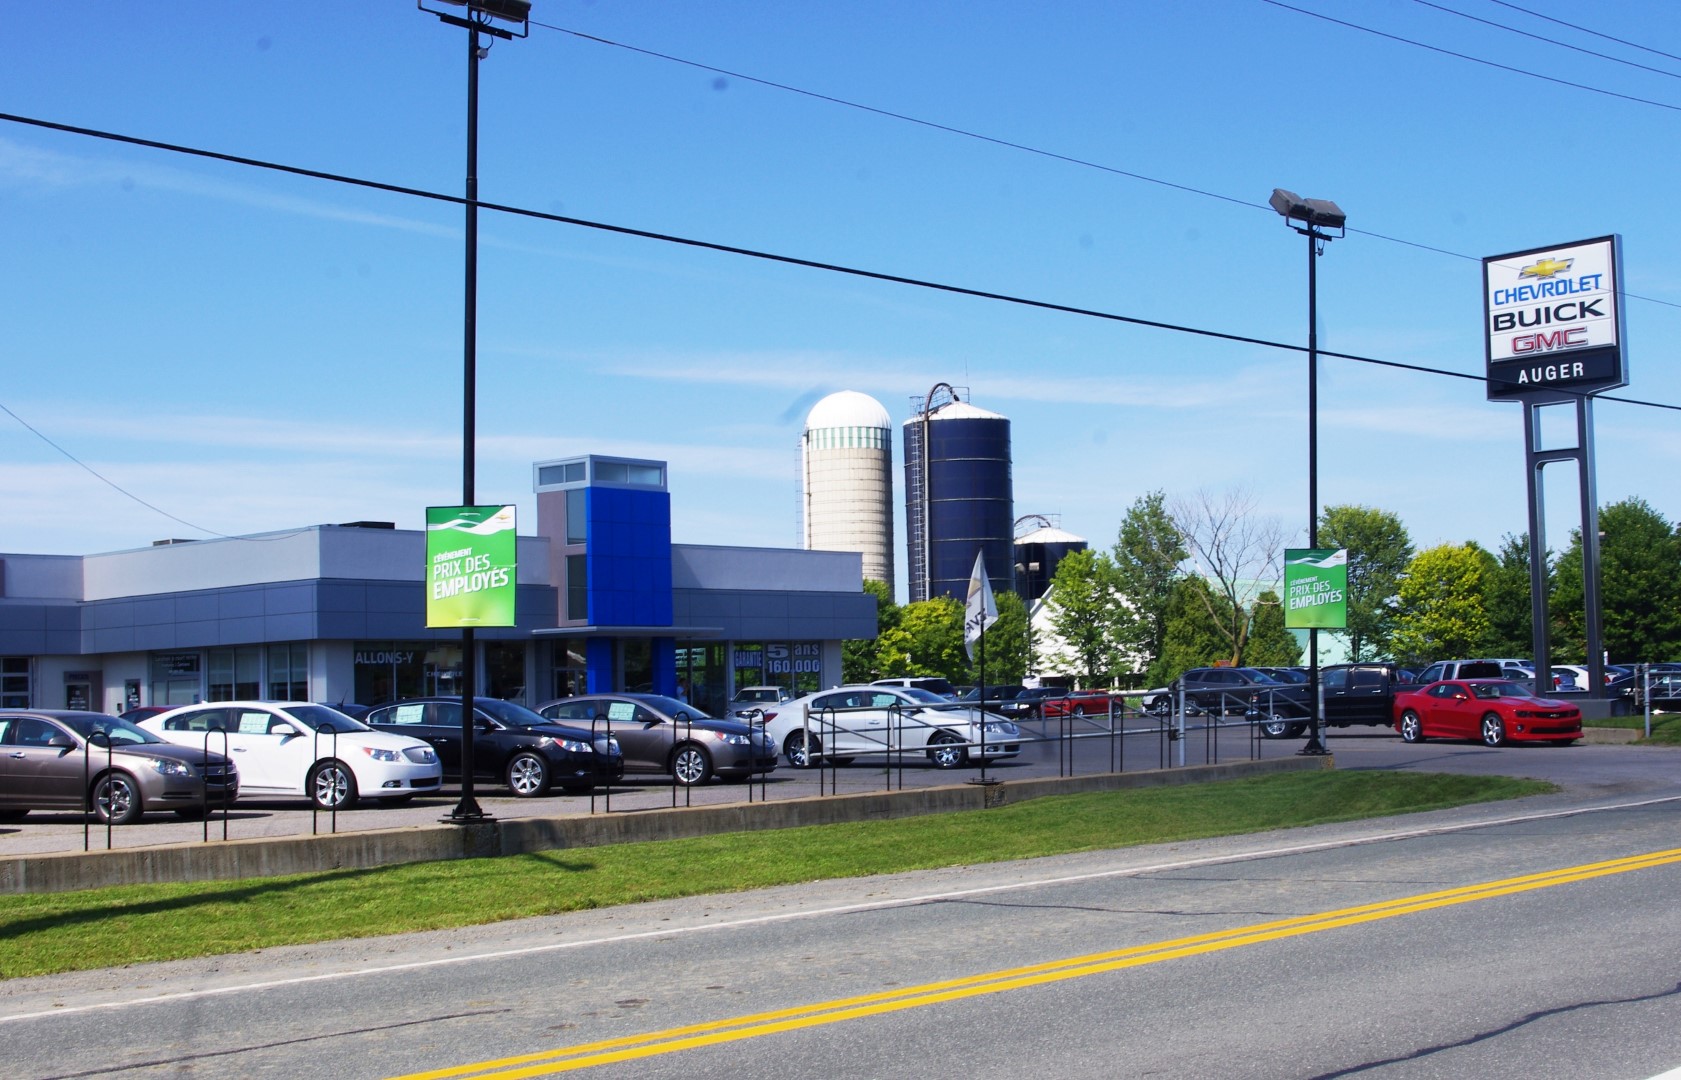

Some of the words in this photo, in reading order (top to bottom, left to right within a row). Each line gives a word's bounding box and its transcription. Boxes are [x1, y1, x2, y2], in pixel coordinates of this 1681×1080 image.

[1494, 273, 1603, 306] CHEVROLET
[1493, 298, 1606, 332] BUICK
[1511, 326, 1589, 355] GMC
[1518, 361, 1584, 384] AUGER
[433, 559, 462, 580] PRIX
[465, 553, 491, 574] DES
[433, 566, 510, 600] EMPLOYÉS
[1290, 583, 1311, 597] PRIX
[1313, 580, 1331, 593] DES
[1290, 588, 1343, 610] EMPLOYÉS
[354, 651, 414, 664] ALLONS-Y
[735, 650, 763, 668] GARANTIE
[767, 643, 789, 659] 5
[794, 643, 819, 656] ans
